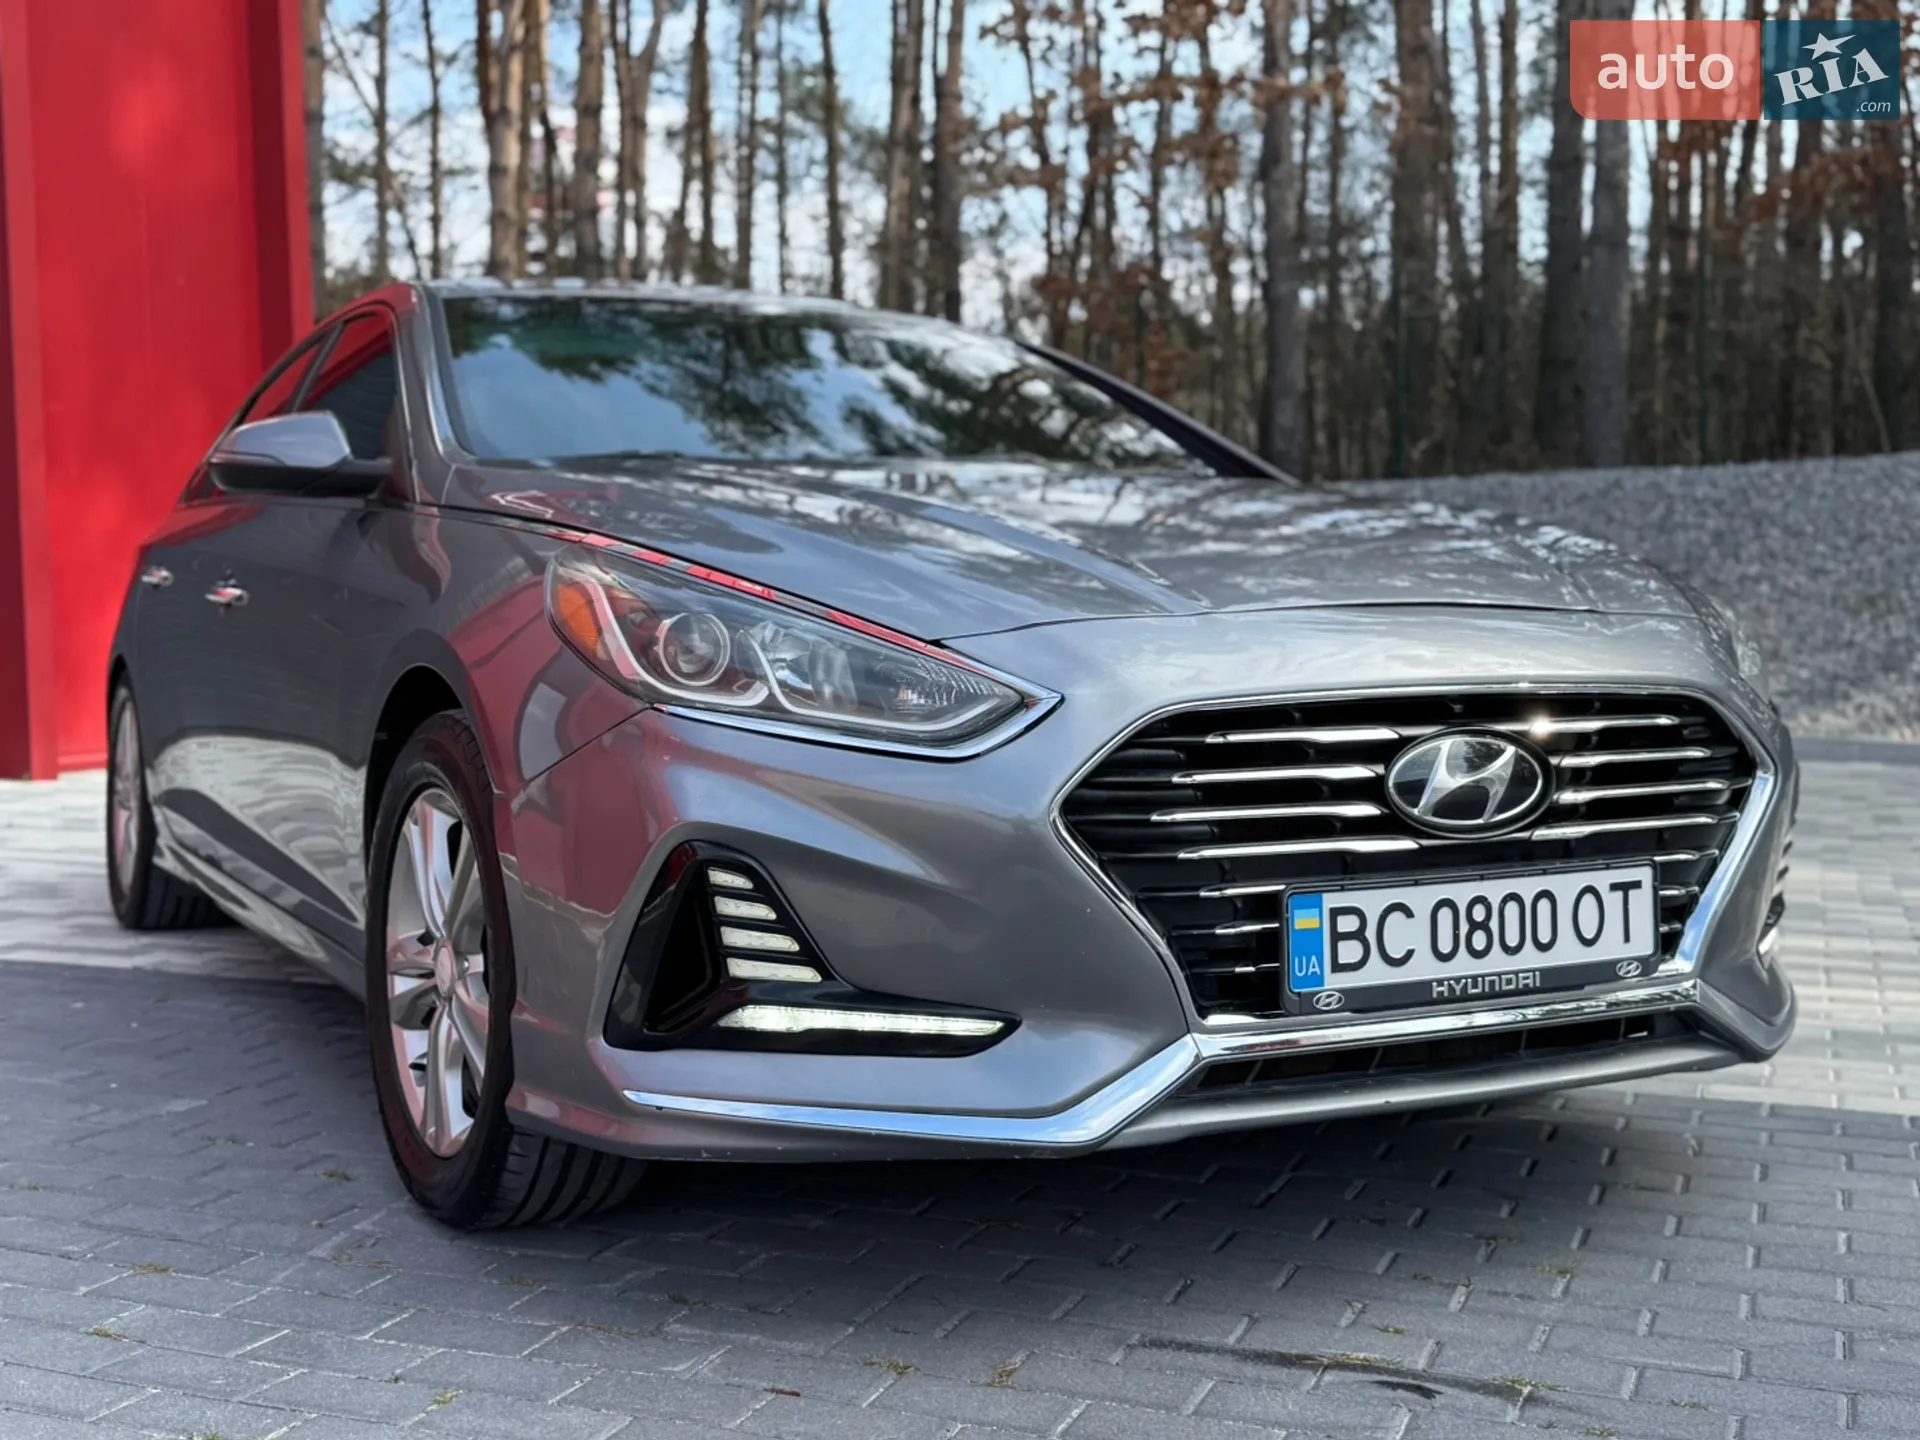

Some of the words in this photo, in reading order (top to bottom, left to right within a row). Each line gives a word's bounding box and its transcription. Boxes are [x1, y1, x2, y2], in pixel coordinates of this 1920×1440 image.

[1329, 902, 1416, 974] BC
[1430, 888, 1558, 963] 0800
[1572, 880, 1643, 948] OT
[1294, 954, 1321, 977] UA
[1431, 971, 1541, 999] HYUNDAI
